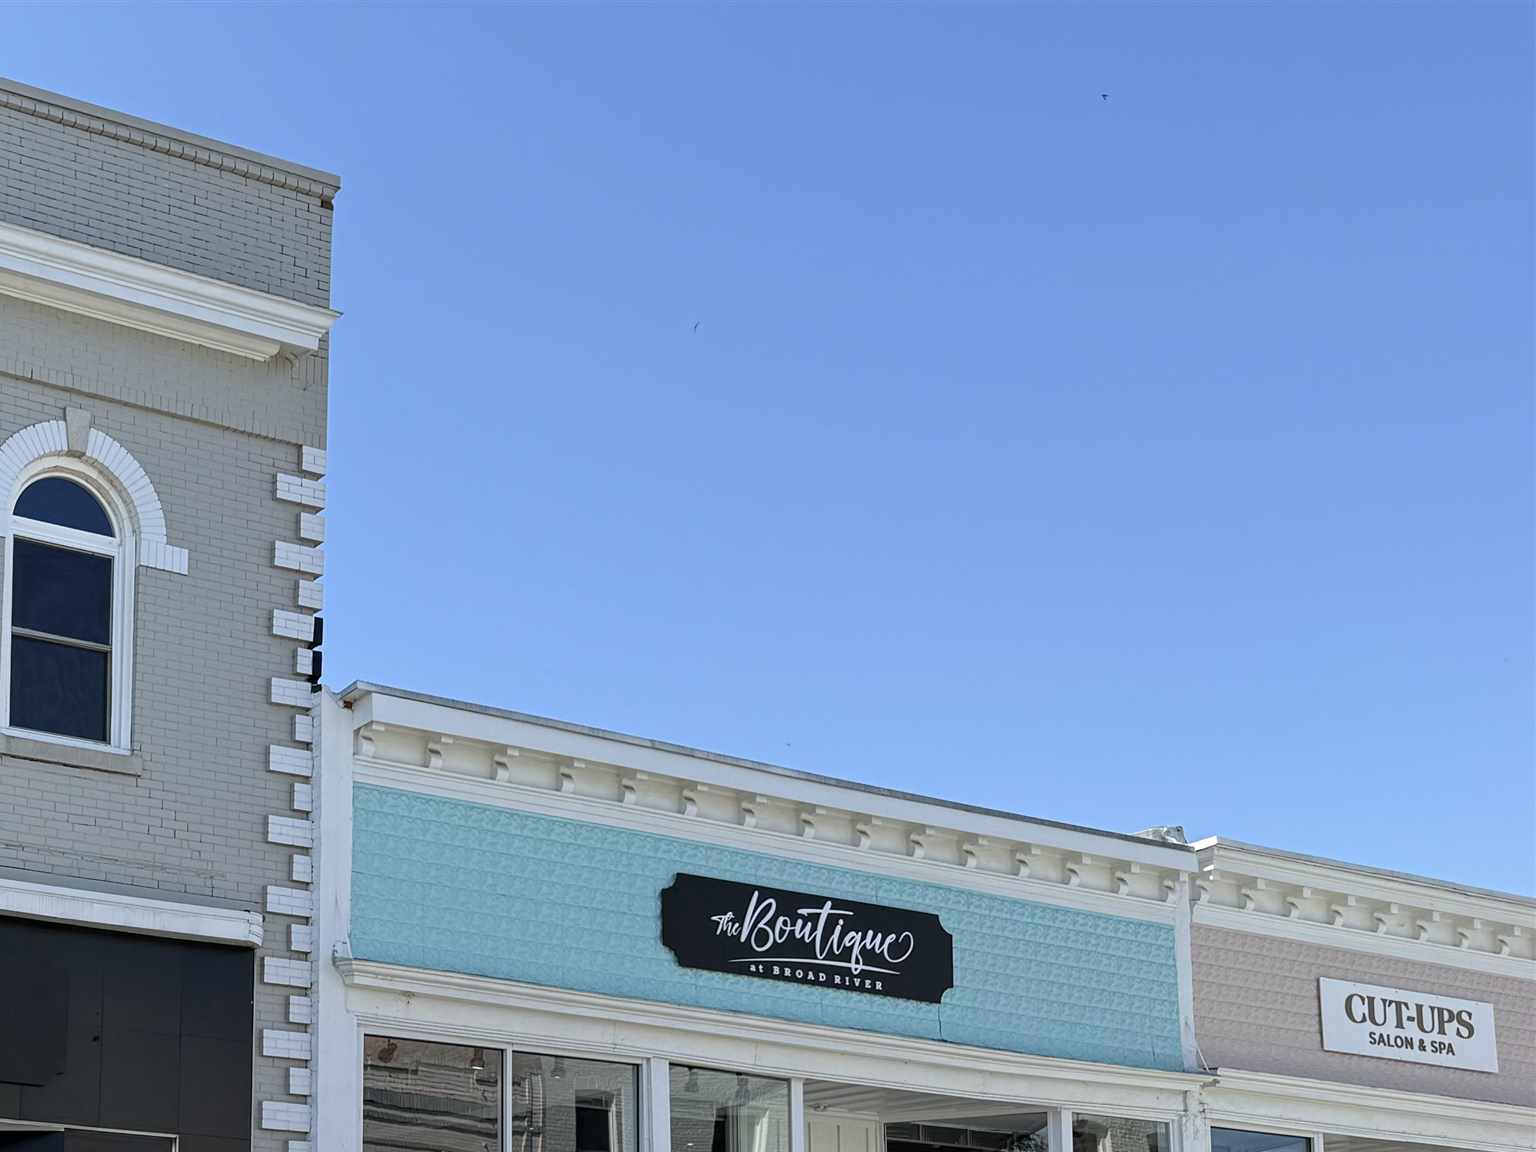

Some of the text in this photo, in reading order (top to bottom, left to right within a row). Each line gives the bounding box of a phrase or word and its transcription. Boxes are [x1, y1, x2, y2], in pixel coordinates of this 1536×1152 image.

[710, 890, 913, 975] The Boutique
[772, 965, 826, 982] BROAD
[834, 974, 883, 991] RIVER
[1344, 993, 1476, 1040] CUT-UPS
[1368, 1031, 1456, 1056] SALON & SPA
